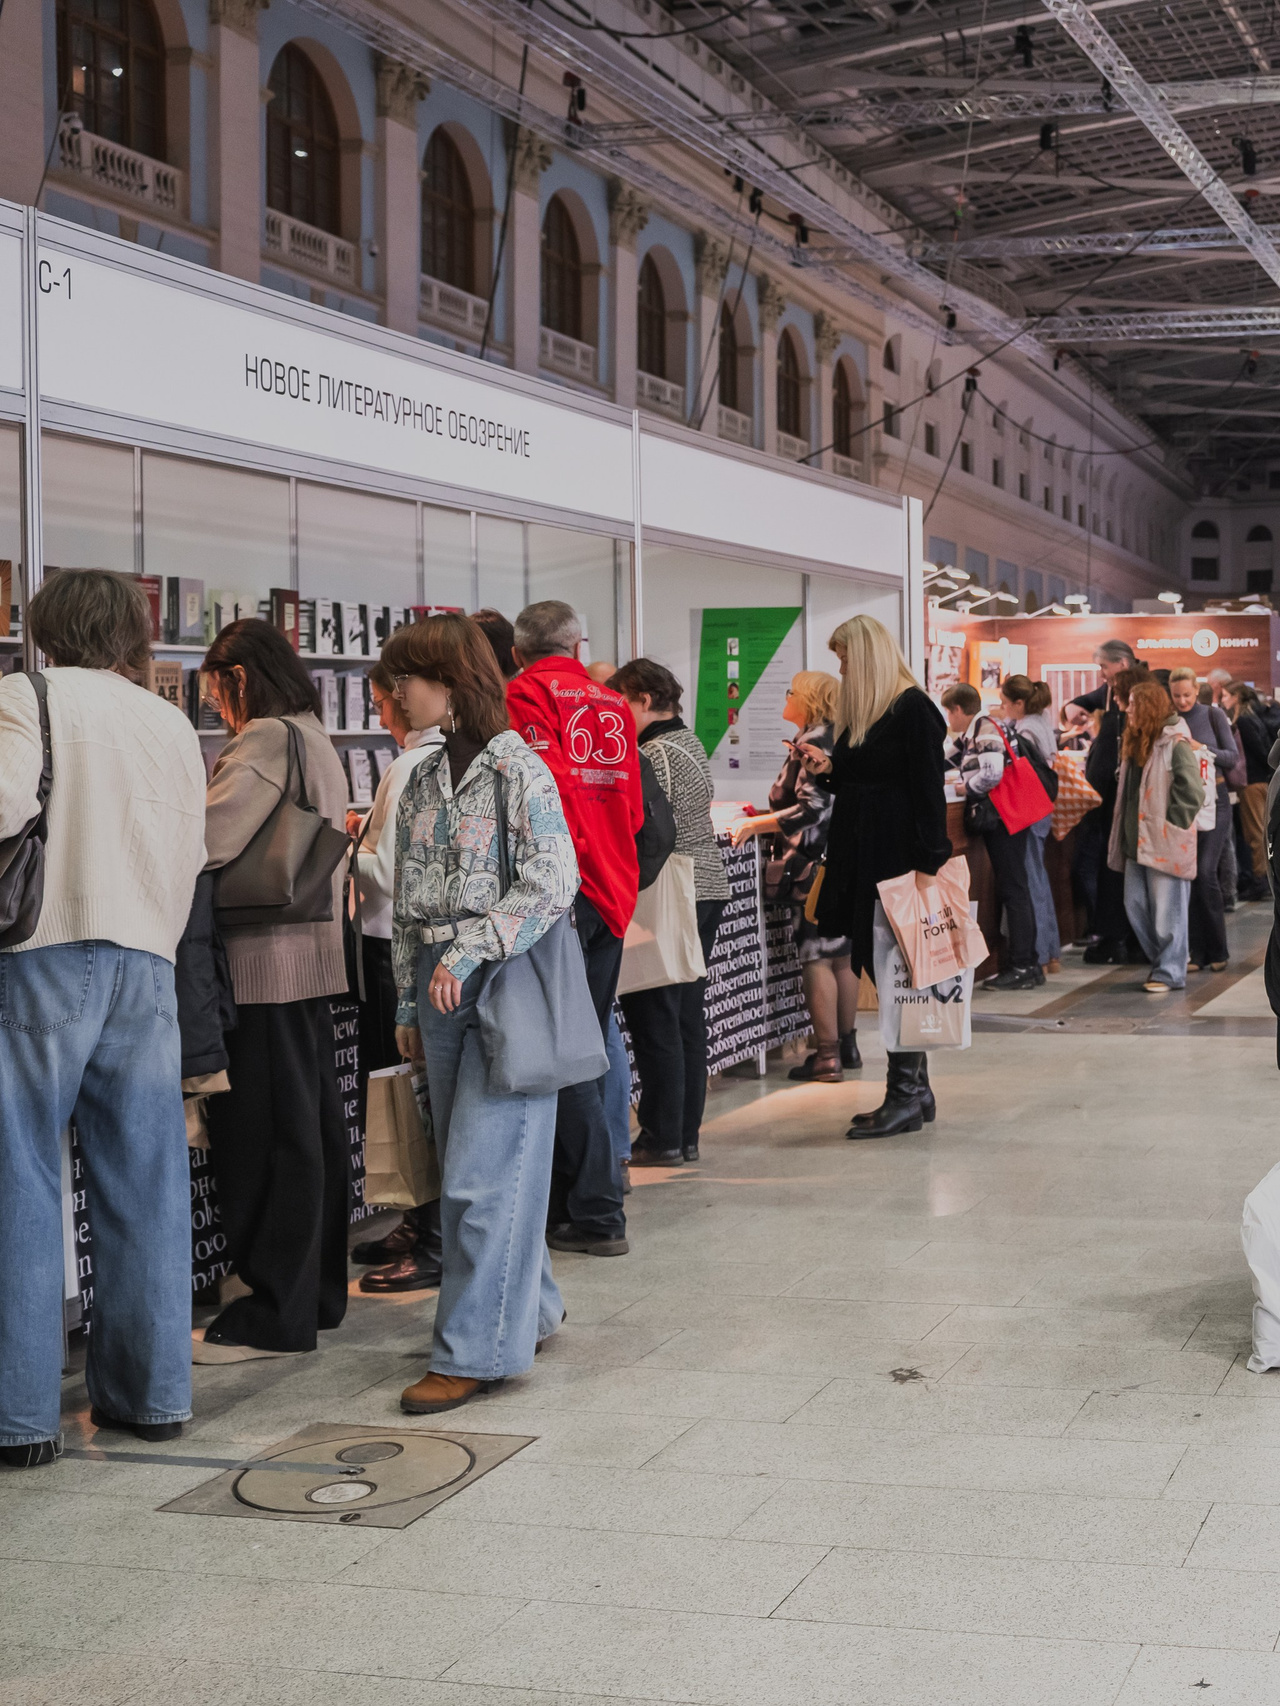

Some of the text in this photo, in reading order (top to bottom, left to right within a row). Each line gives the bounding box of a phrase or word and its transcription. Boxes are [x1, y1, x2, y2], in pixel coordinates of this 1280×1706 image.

[245, 353, 530, 458] НОВОЕ ЛИТЕРАТУРНОЕ ОБОЗРЕНИЕ
[565, 704, 628, 765] 63
[923, 921, 958, 940] ГОРД
[894, 995, 929, 1005] книги
